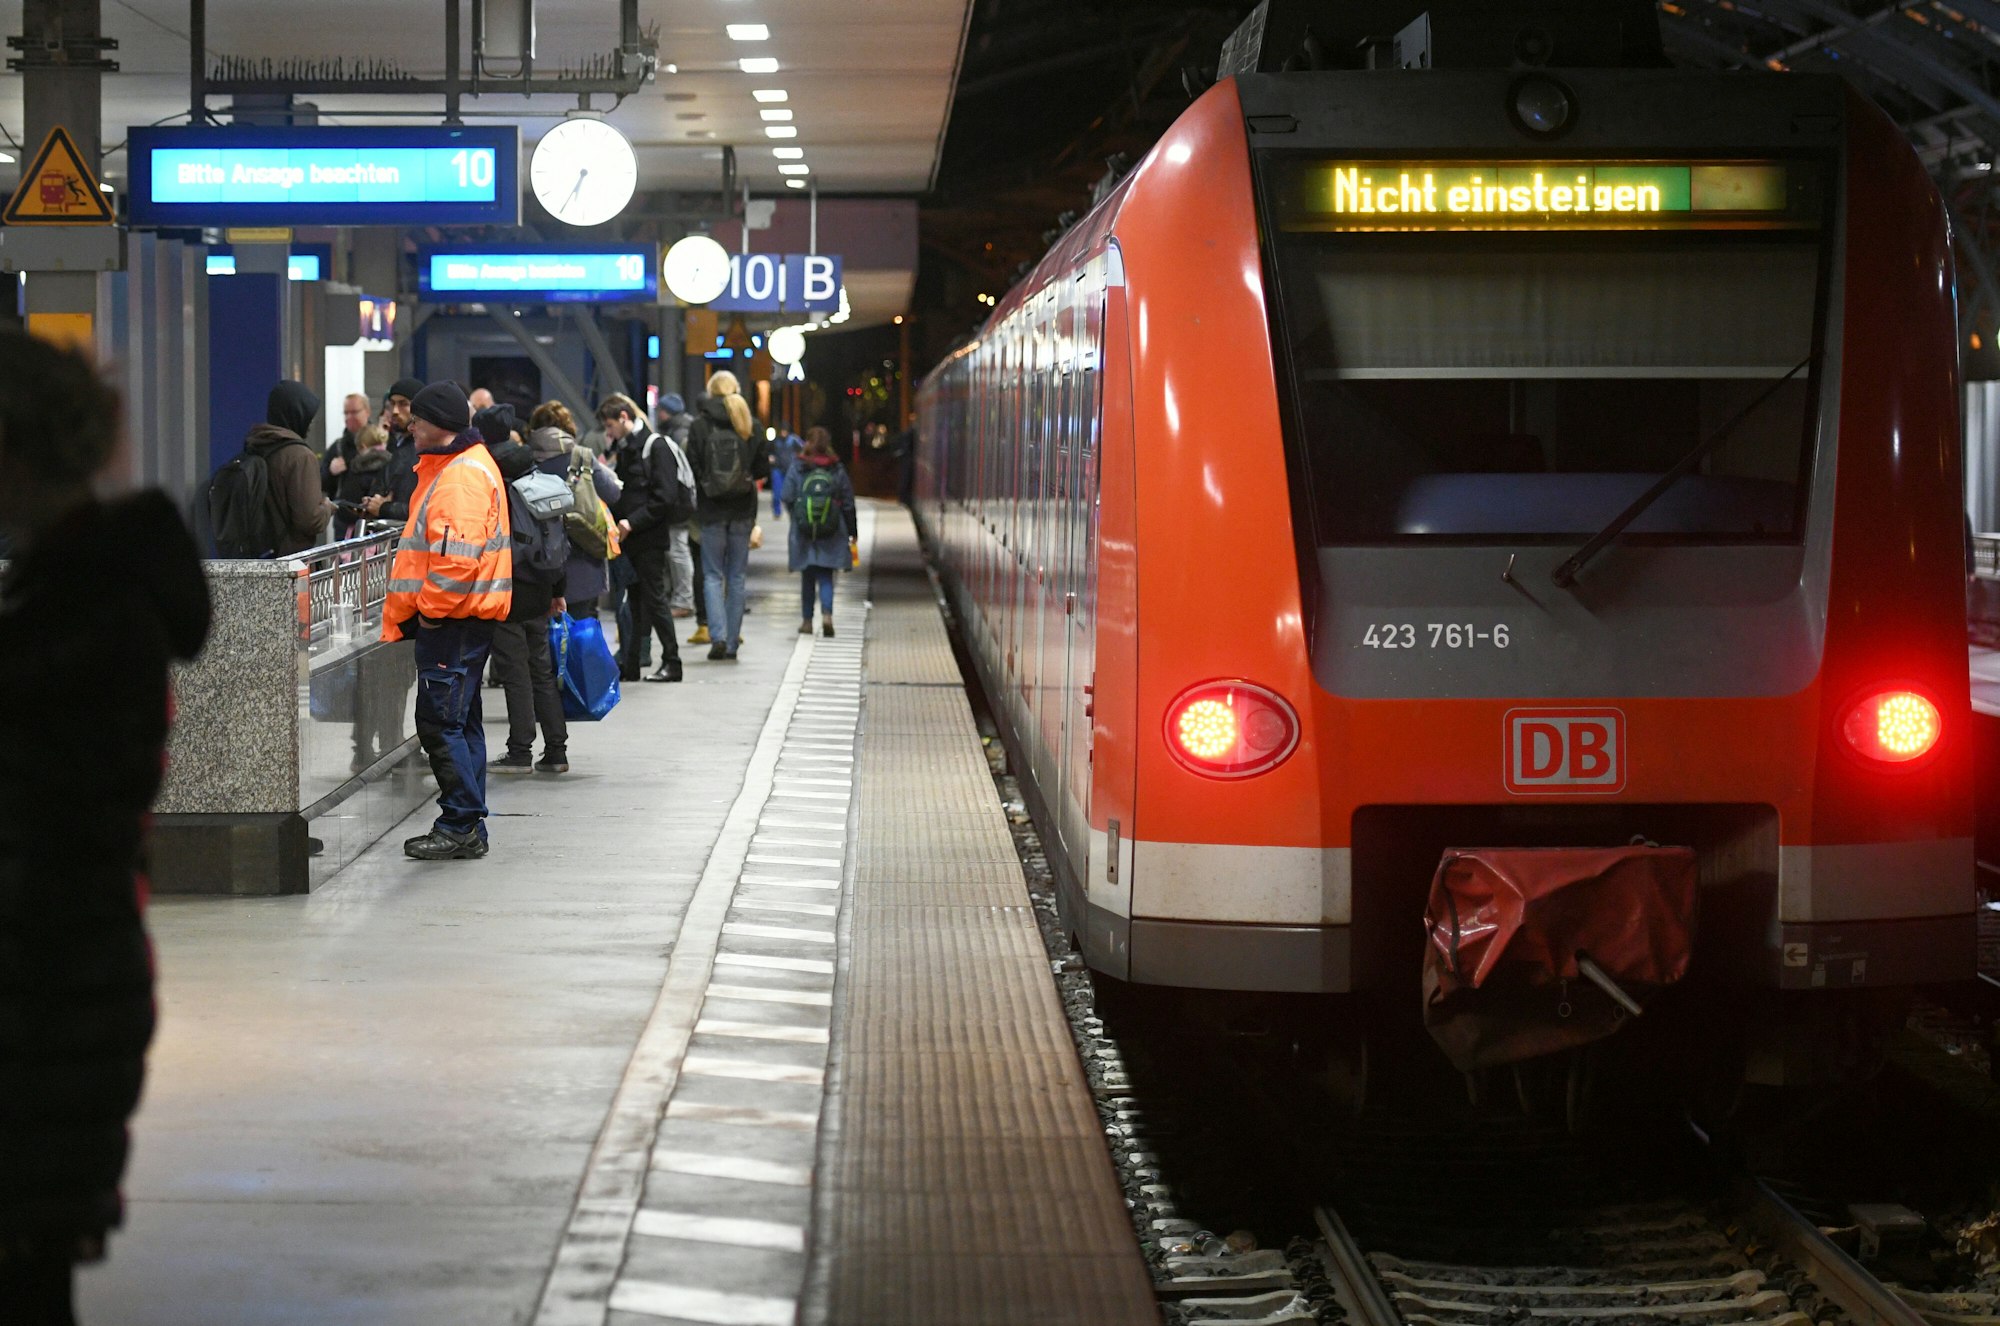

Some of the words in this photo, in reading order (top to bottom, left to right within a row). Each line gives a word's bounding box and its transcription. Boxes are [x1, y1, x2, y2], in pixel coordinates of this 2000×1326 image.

[178, 163, 224, 184] Bitte
[231, 163, 304, 188] Ansage
[309, 162, 399, 184] beachten
[451, 150, 493, 187] 10
[1334, 168, 1436, 213] Nicht
[1447, 174, 1660, 212] einsteigen
[614, 255, 644, 281] 10
[730, 255, 774, 300] 10
[803, 256, 836, 301] B
[1363, 624, 1416, 648] 423
[1428, 623, 1510, 648] 761-6
[1520, 722, 1611, 778] DB
